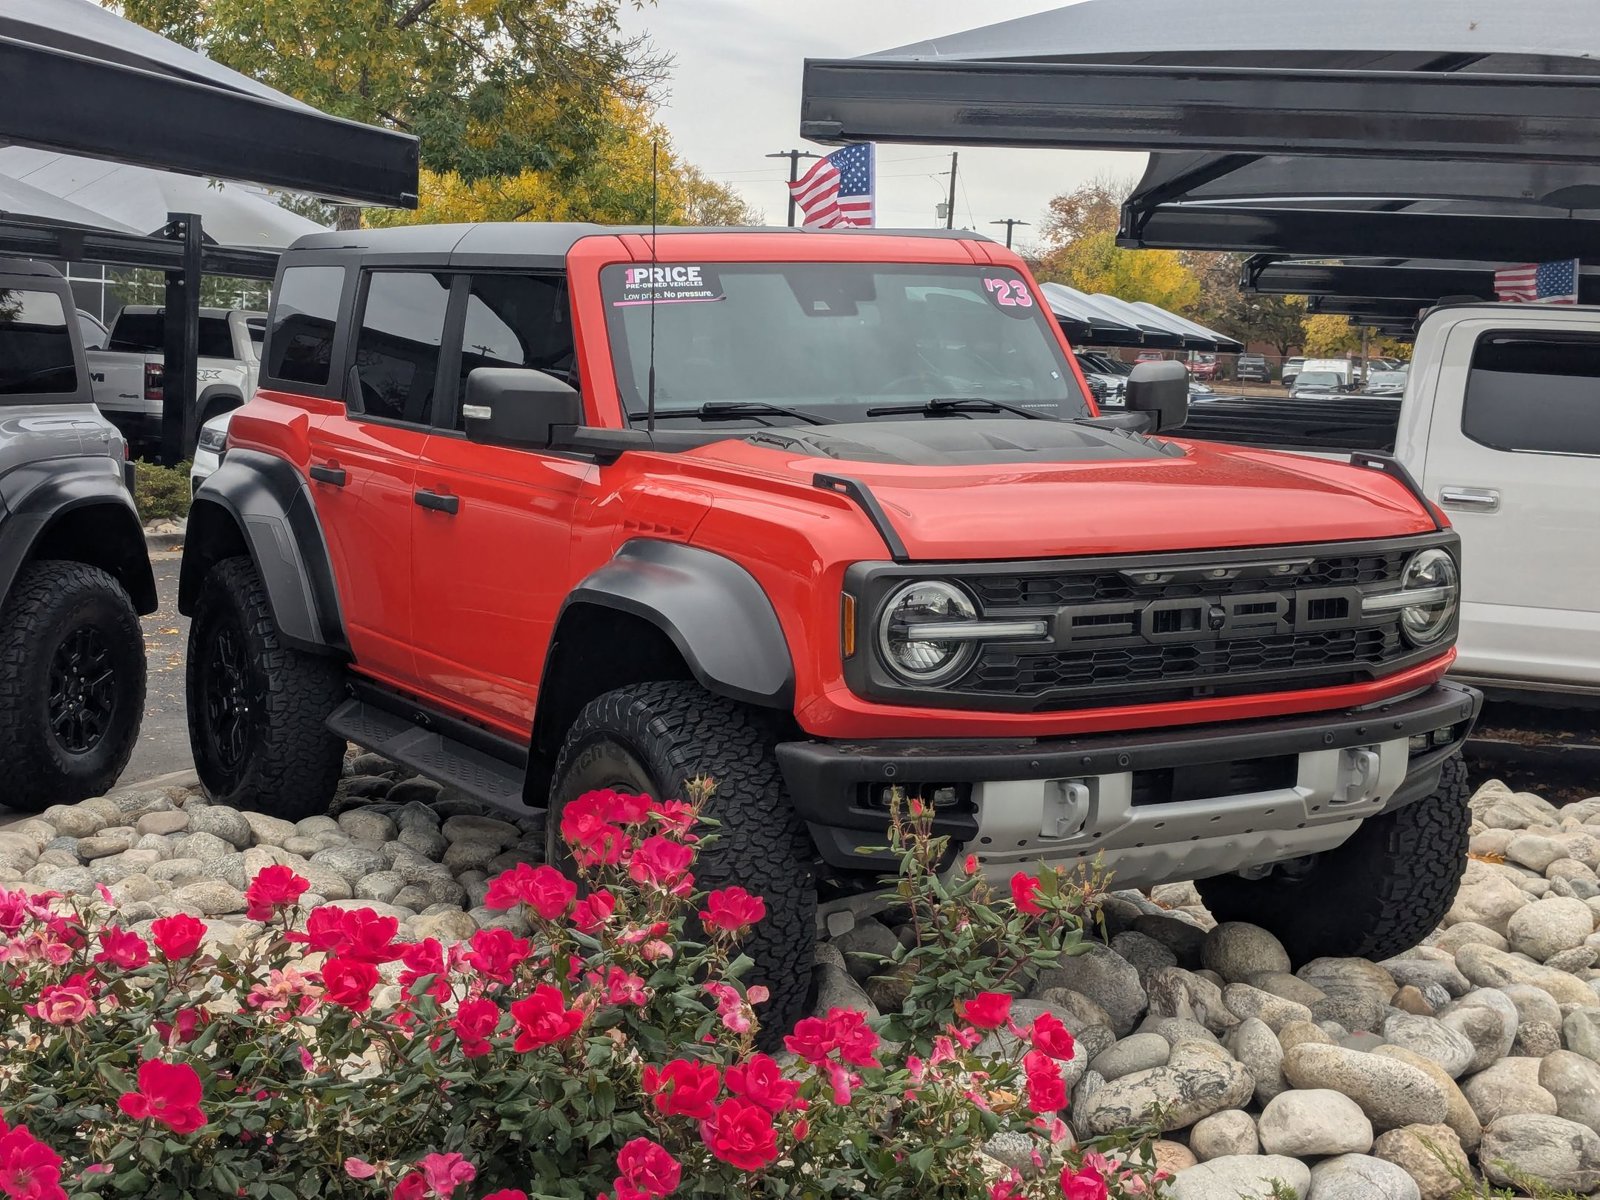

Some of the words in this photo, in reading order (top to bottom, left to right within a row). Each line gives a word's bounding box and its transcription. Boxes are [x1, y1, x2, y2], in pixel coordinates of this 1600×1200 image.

[625, 266, 702, 284] 1PRICE
[641, 291, 662, 300] prie.
[677, 290, 714, 299] pressure.
[984, 278, 1032, 306] '23
[1058, 586, 1362, 650] FORD
